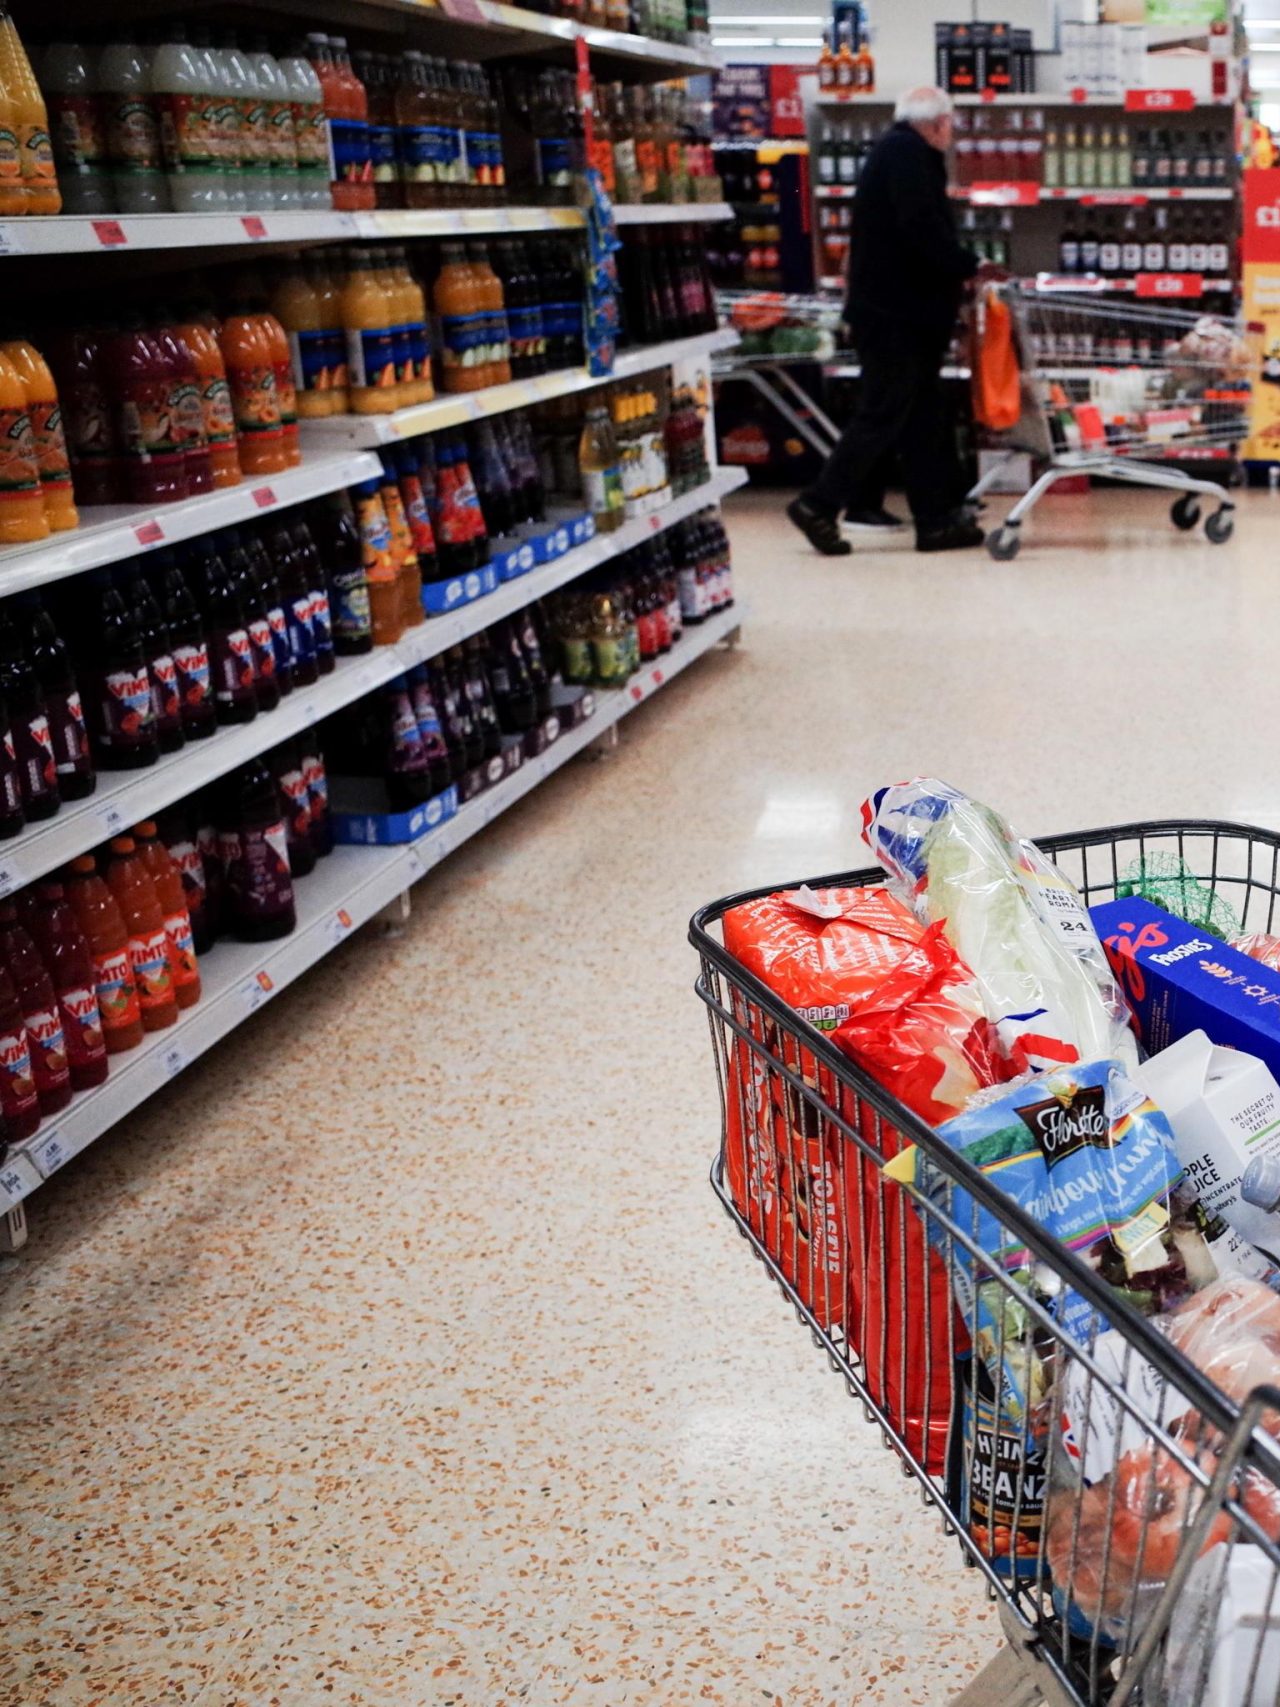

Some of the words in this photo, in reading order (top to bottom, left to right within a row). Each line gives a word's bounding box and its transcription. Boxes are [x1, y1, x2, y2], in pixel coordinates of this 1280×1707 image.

[1060, 921, 1087, 931] 24
[1230, 1114, 1243, 1124] THE
[1243, 1098, 1266, 1117] SECRET
[1266, 1093, 1274, 1101] OF
[1240, 1118, 1253, 1129] OUR
[1253, 1103, 1275, 1120] FRUITY
[1037, 1104, 1108, 1151] Florette
